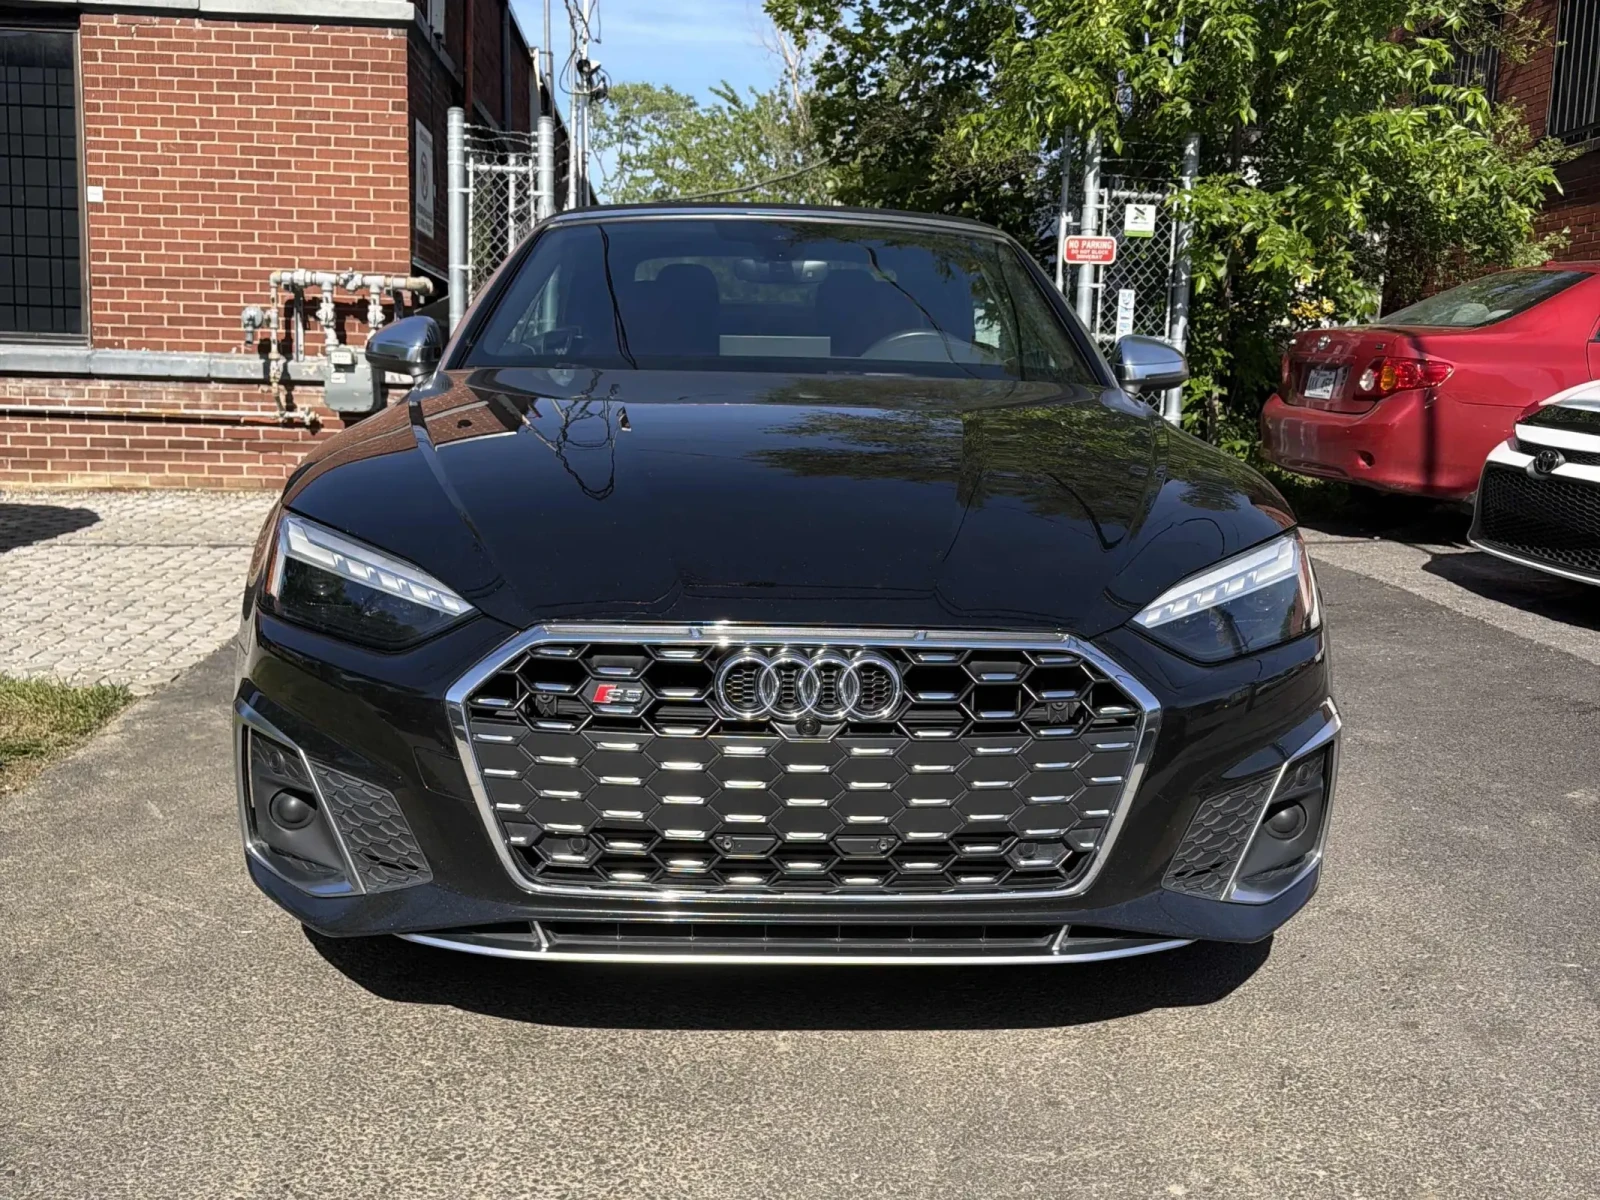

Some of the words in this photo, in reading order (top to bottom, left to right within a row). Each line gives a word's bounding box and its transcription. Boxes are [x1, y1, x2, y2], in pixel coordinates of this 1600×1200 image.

[1069, 240, 1079, 249] NO
[1081, 240, 1112, 249] PARKING
[605, 688, 643, 702] S5
